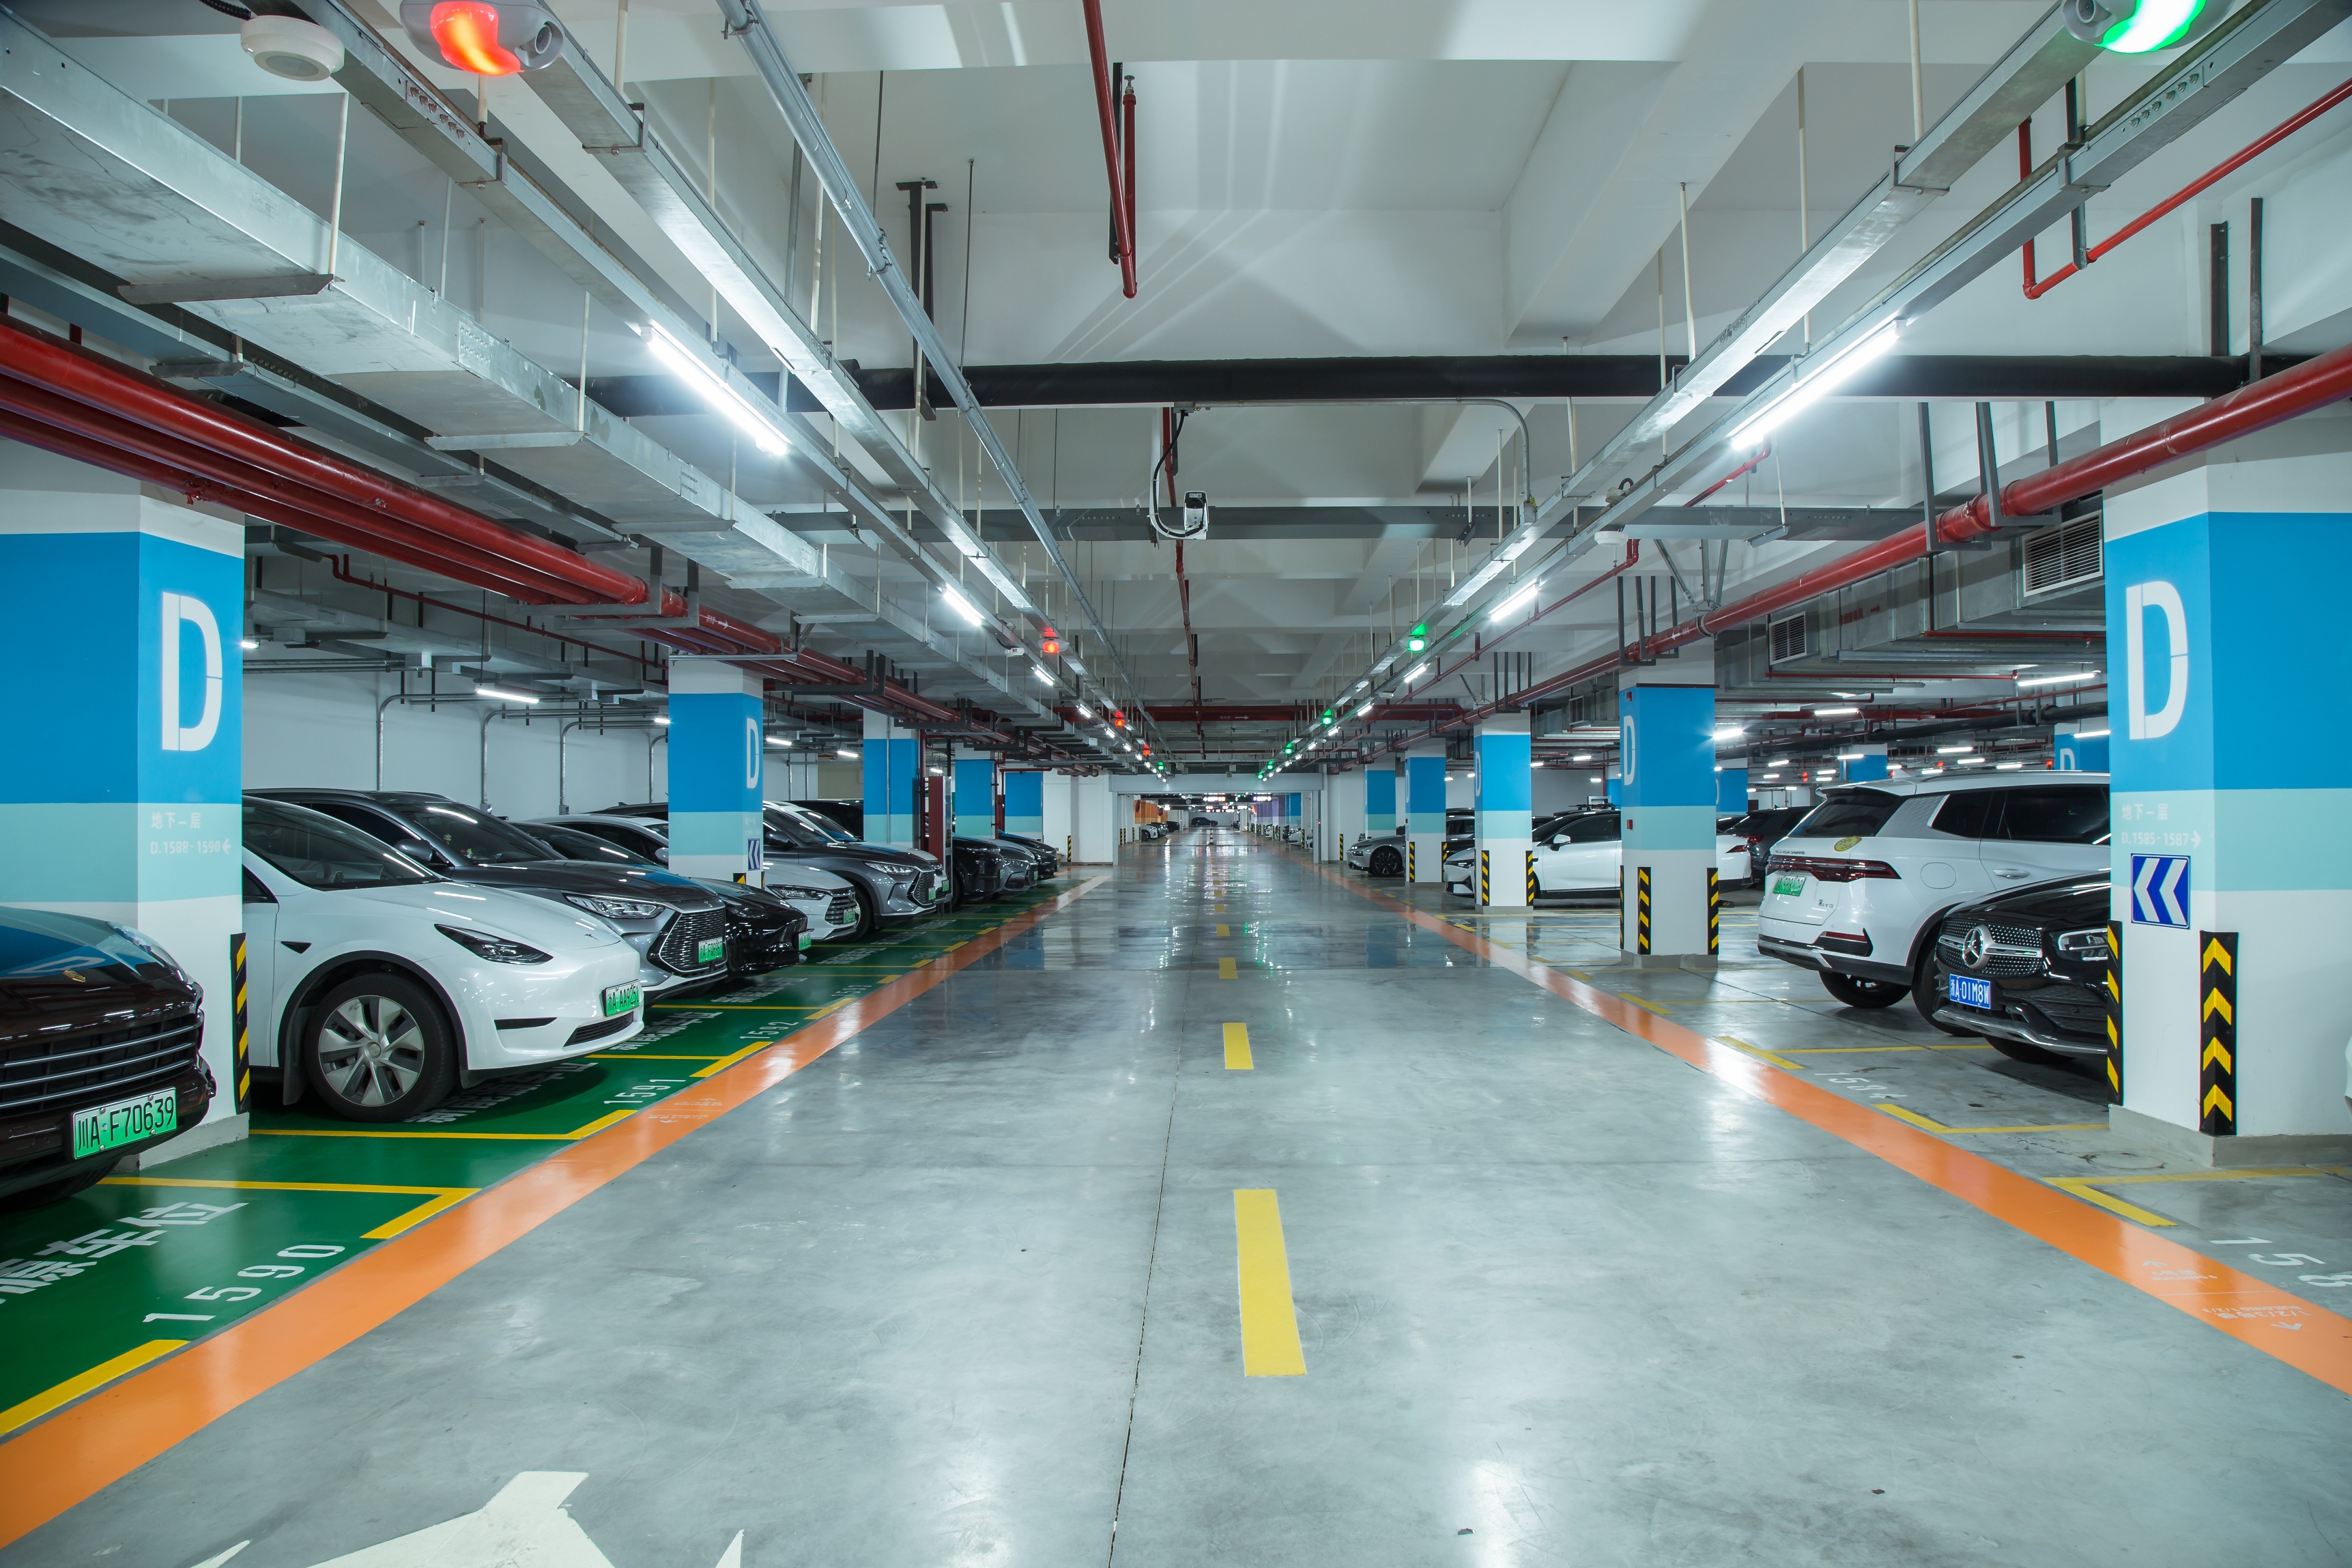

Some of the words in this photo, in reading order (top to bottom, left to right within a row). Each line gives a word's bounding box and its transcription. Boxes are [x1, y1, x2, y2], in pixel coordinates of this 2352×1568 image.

[162, 592, 223, 752] D
[2126, 581, 2188, 740] D
[747, 718, 759, 789] D
[1624, 716, 1635, 785] D
[1475, 752, 1481, 797] D
[151, 812, 201, 829] 地下一层
[2122, 804, 2168, 820] 地下一层
[832, 984, 872, 996] 1593
[739, 1022, 799, 1039] 1592
[603, 1079, 686, 1104] 1591
[1814, 1072, 1908, 1099] 1584
[143, 1245, 345, 1323] 1590
